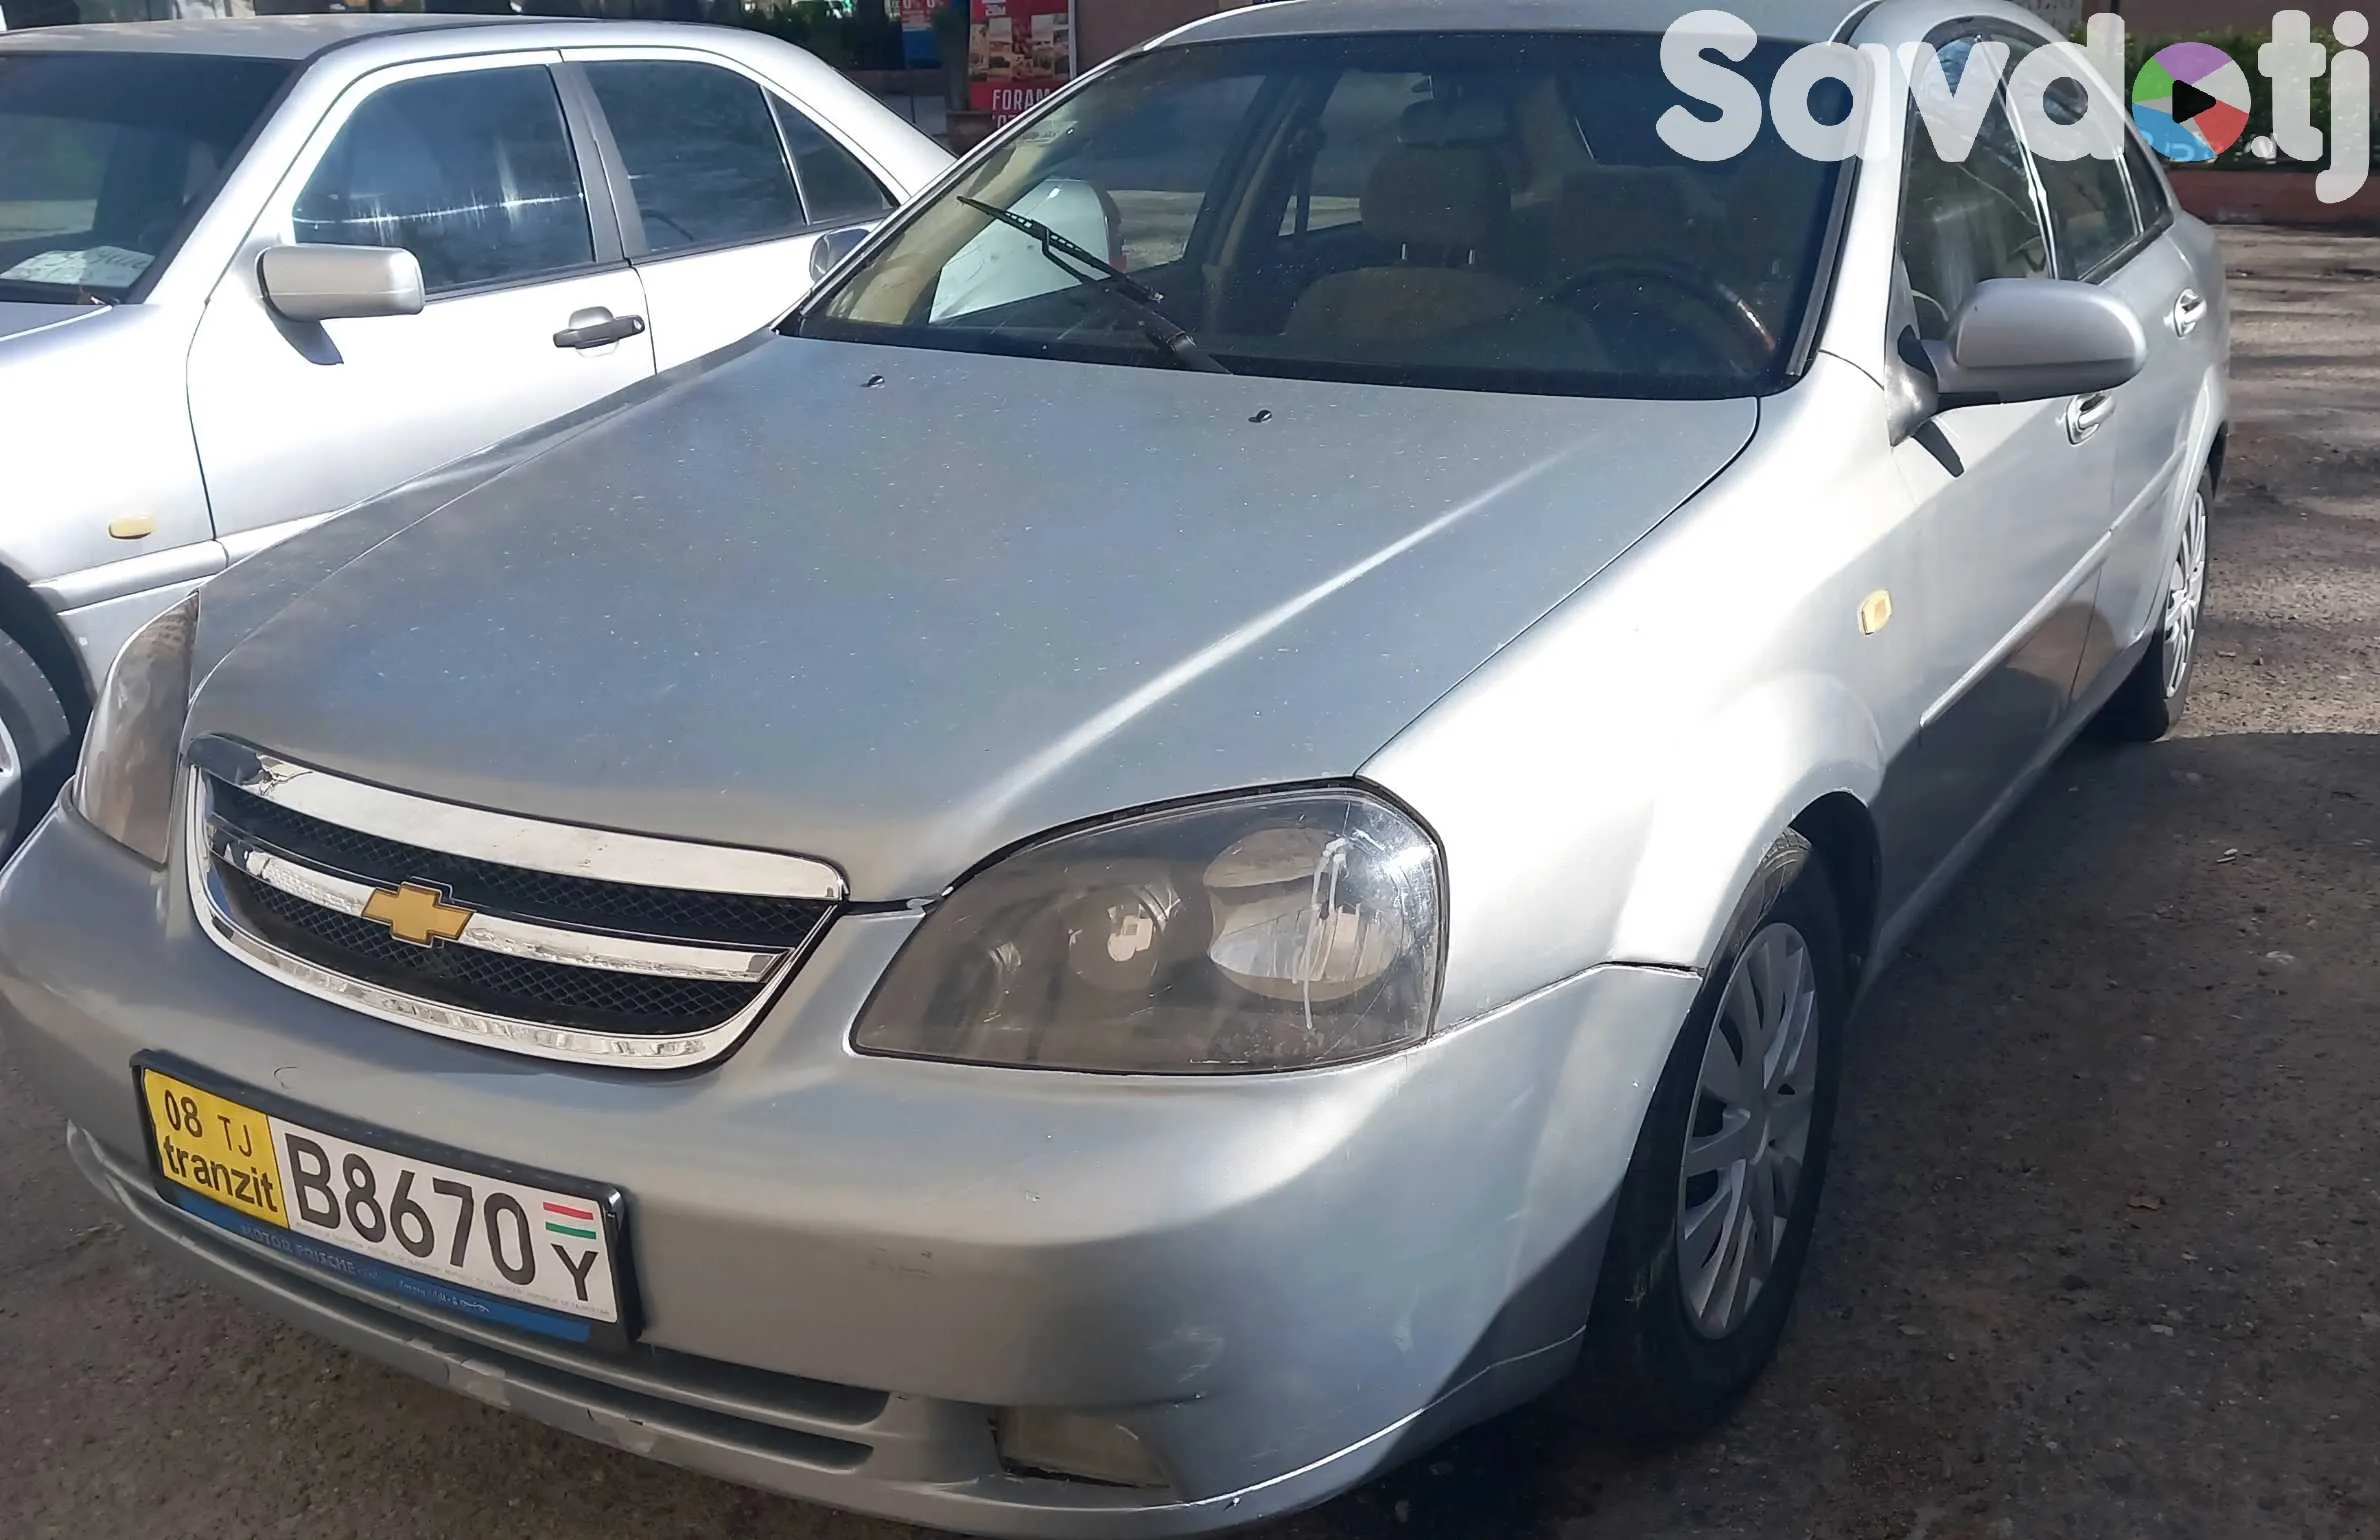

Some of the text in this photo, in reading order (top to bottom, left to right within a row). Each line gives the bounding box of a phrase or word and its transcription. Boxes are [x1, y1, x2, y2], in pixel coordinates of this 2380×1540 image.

[163, 1088, 253, 1158] 08 TJ
[163, 1135, 279, 1213] tranzit
[284, 1132, 537, 1286] B8670
[551, 1243, 600, 1302] Y
